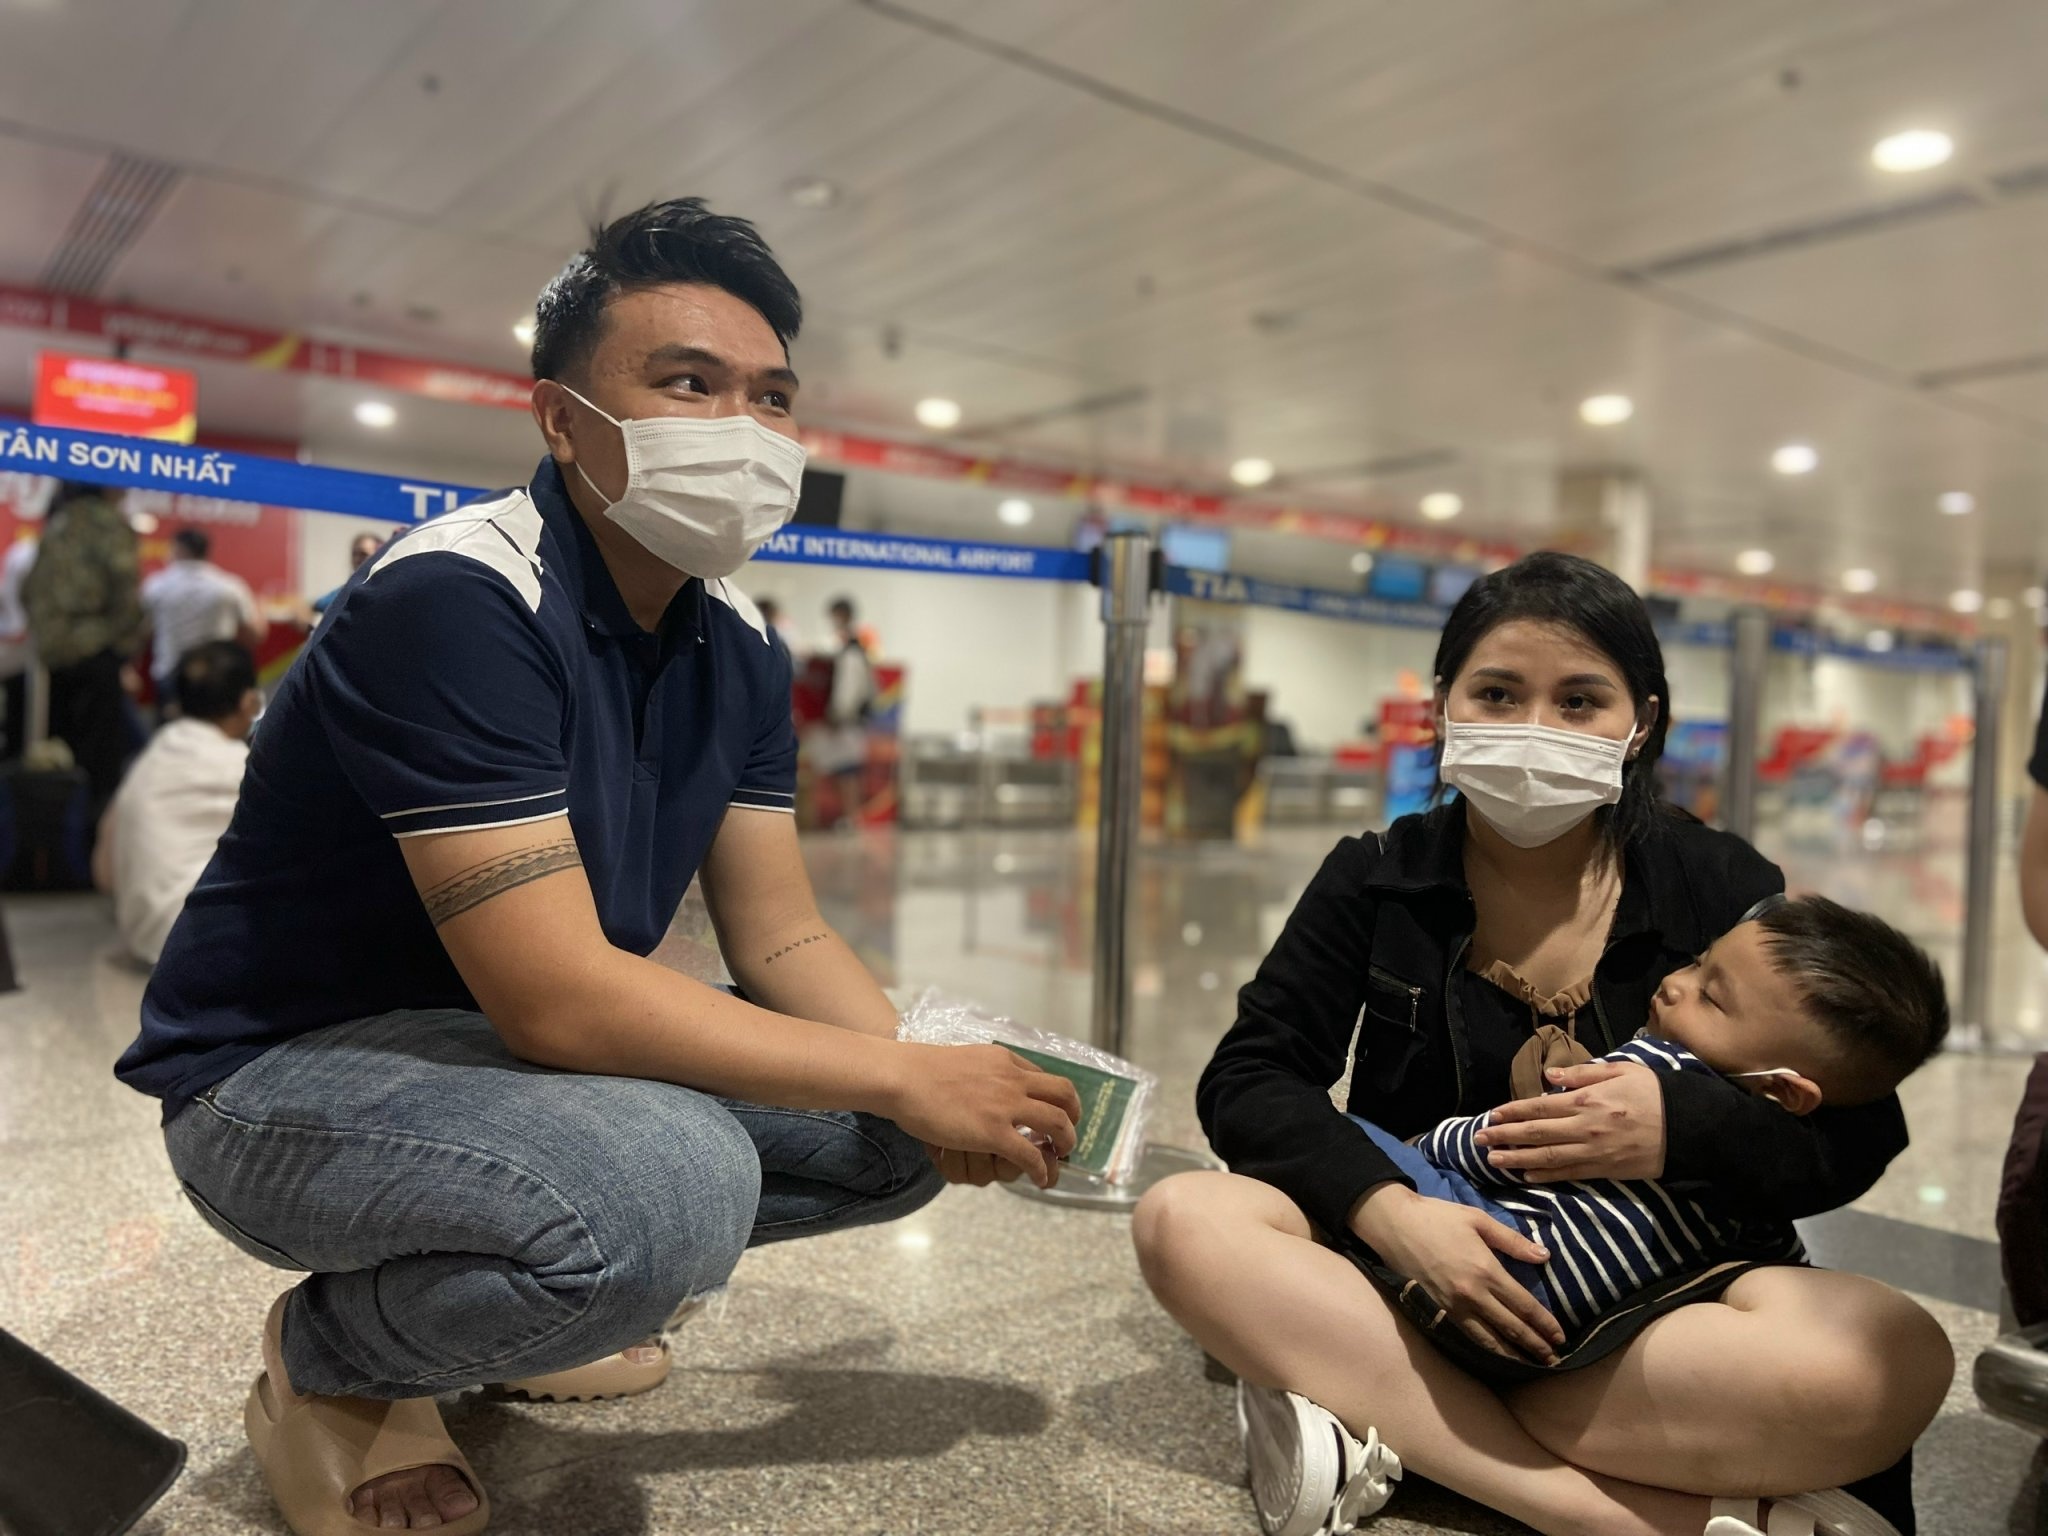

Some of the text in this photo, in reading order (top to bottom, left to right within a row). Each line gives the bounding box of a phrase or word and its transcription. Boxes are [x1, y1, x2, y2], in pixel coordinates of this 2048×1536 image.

[0, 428, 236, 485] TÂN SƠN NHẤT
[400, 484, 458, 519] TI
[760, 533, 1036, 573] HAT INTERNATIONAL AIRPORT
[765, 933, 827, 964] BRAVERY
